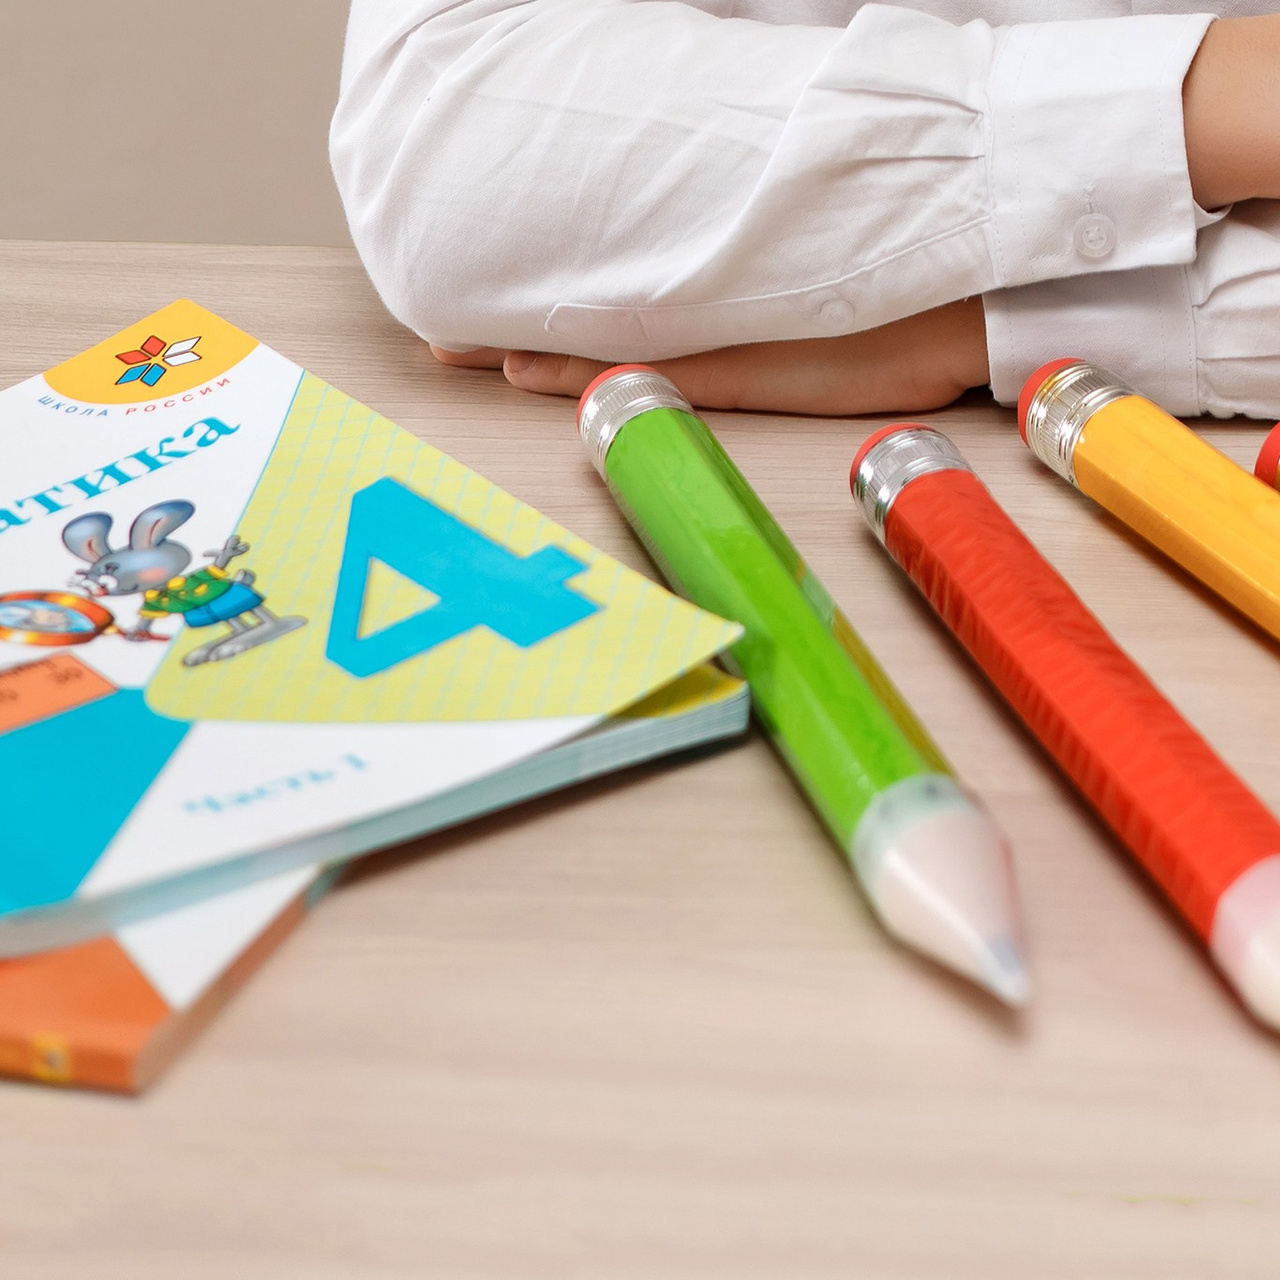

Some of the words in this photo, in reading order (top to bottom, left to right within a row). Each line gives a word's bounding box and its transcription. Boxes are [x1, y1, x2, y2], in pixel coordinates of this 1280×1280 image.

[38, 394, 109, 417] ШКОЛА
[125, 377, 232, 416] РОССИИ
[325, 475, 605, 679] 4
